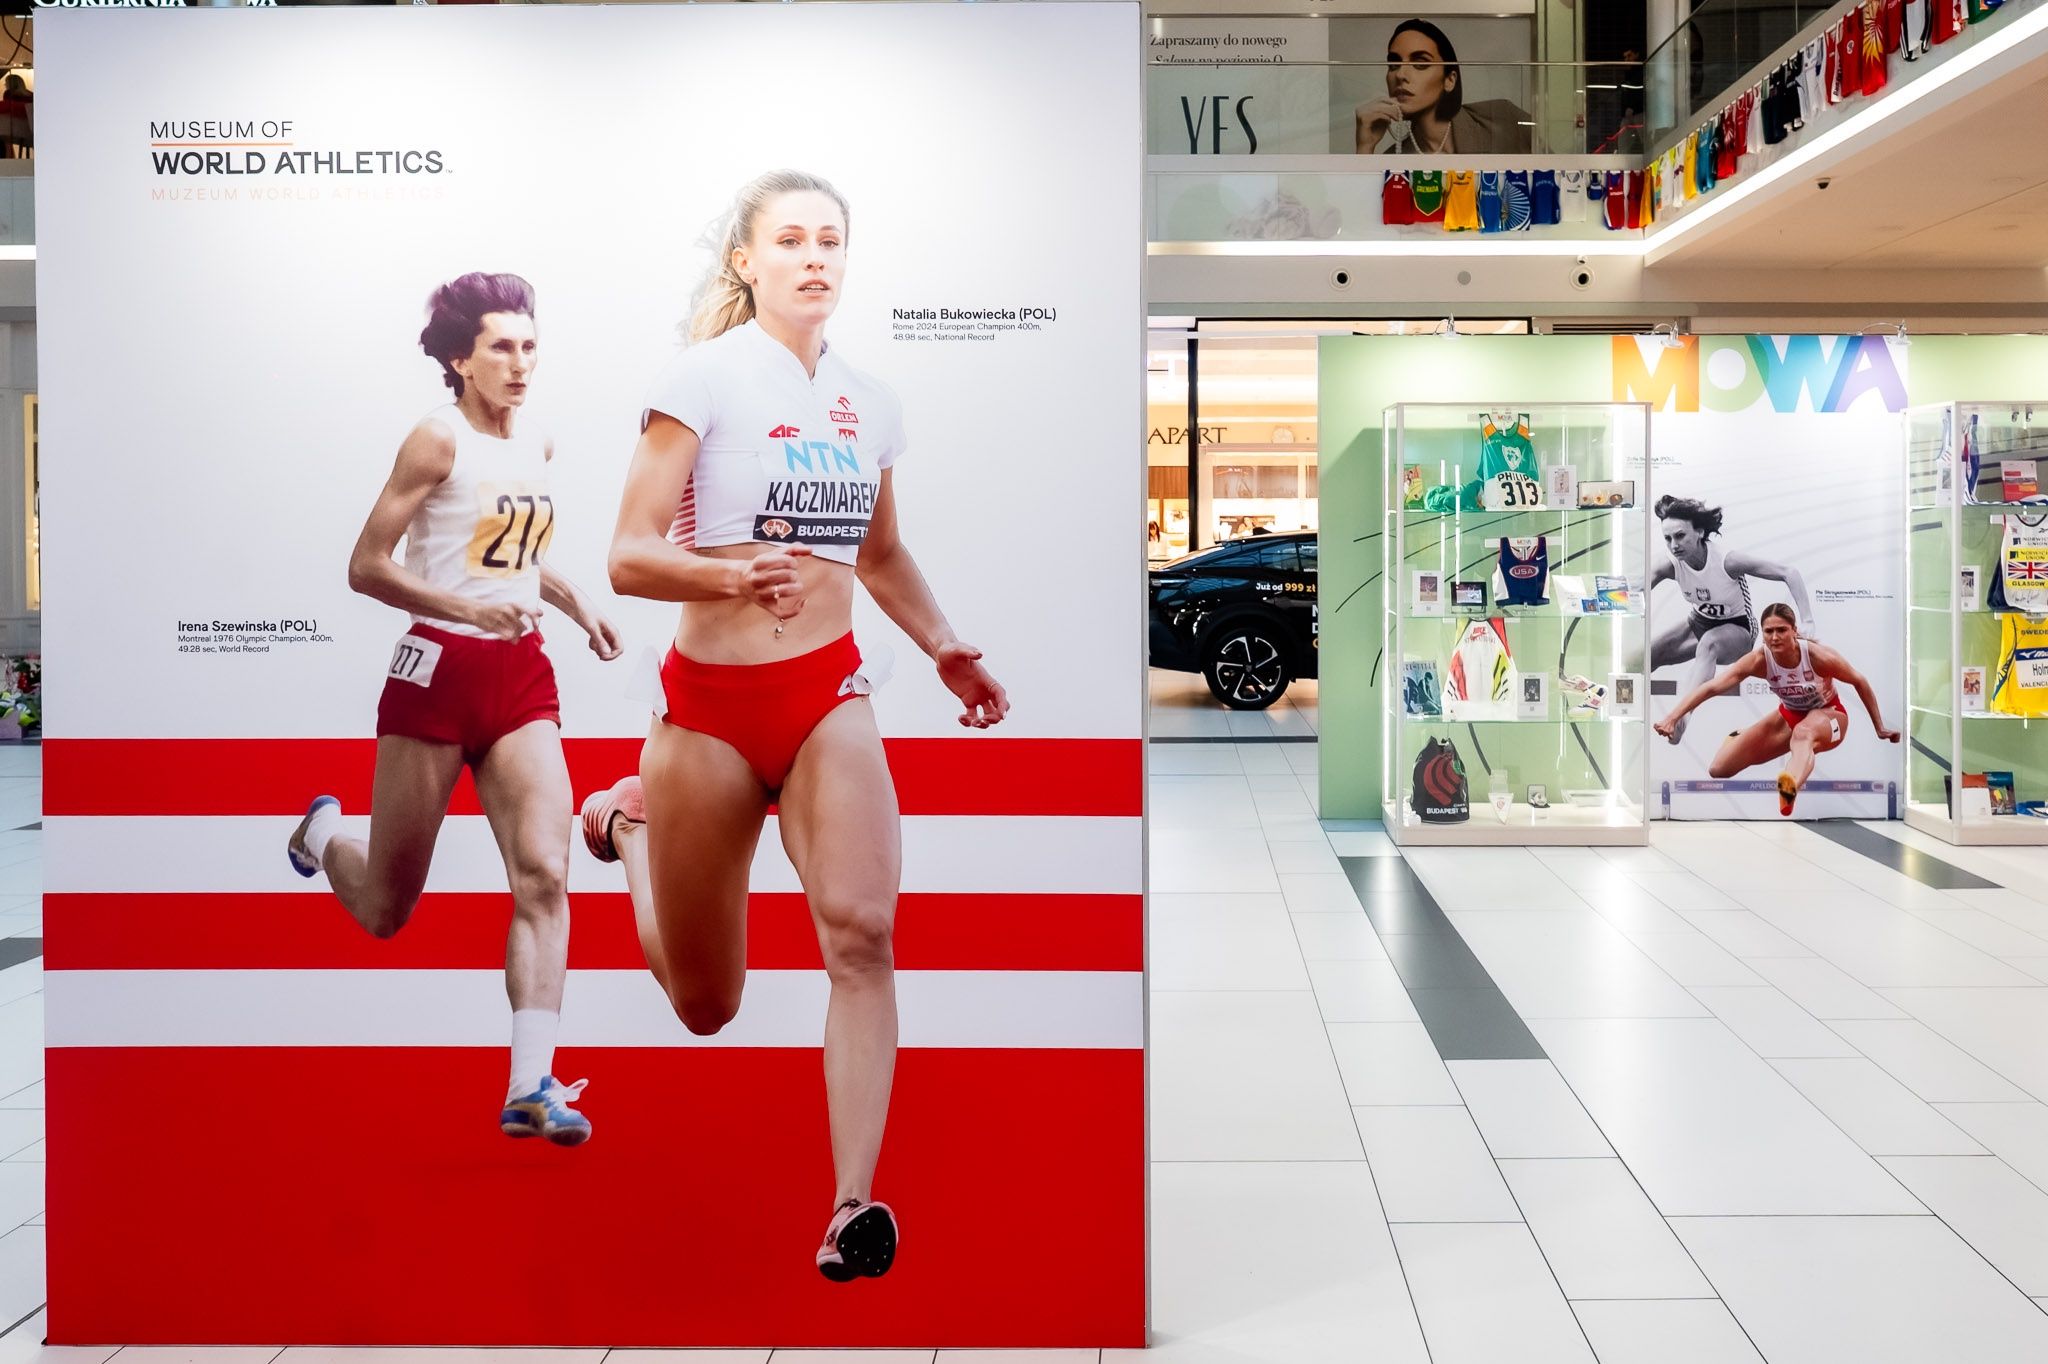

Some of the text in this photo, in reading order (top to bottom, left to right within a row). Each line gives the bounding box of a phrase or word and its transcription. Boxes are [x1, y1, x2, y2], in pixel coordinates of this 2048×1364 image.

[1150, 34, 1287, 48] Zapraszamy do nowego
[150, 120, 293, 138] MUSEUM OF
[152, 150, 444, 174] WORLD ATHLETICS
[151, 186, 445, 200] MUZEUM WORLD ATHLETICS
[893, 307, 1057, 322] Natalia Bukowiecka (POL)
[892, 322, 1042, 333] Rome 2024 European Champion 400m,
[893, 333, 995, 343] 48.98 sec, National Record
[1612, 335, 1908, 413] MOWA
[1148, 427, 1227, 445] APART
[784, 441, 860, 474] NTN
[1497, 472, 1533, 481] PHILIP
[765, 481, 877, 513] KACZMAREK
[1501, 482, 1538, 506] 313
[482, 494, 554, 570] 277
[797, 524, 868, 538] BUDAPEST
[1514, 567, 1534, 576] USA
[1256, 582, 1271, 591] Już
[1285, 583, 1304, 592] 999
[178, 619, 317, 633] Irena Szewinska (POL)
[178, 634, 334, 644] Montreal 1976 Olympic Champion, 400m,
[178, 645, 270, 654] 49.28 sec, World Record
[391, 644, 425, 678] 277
